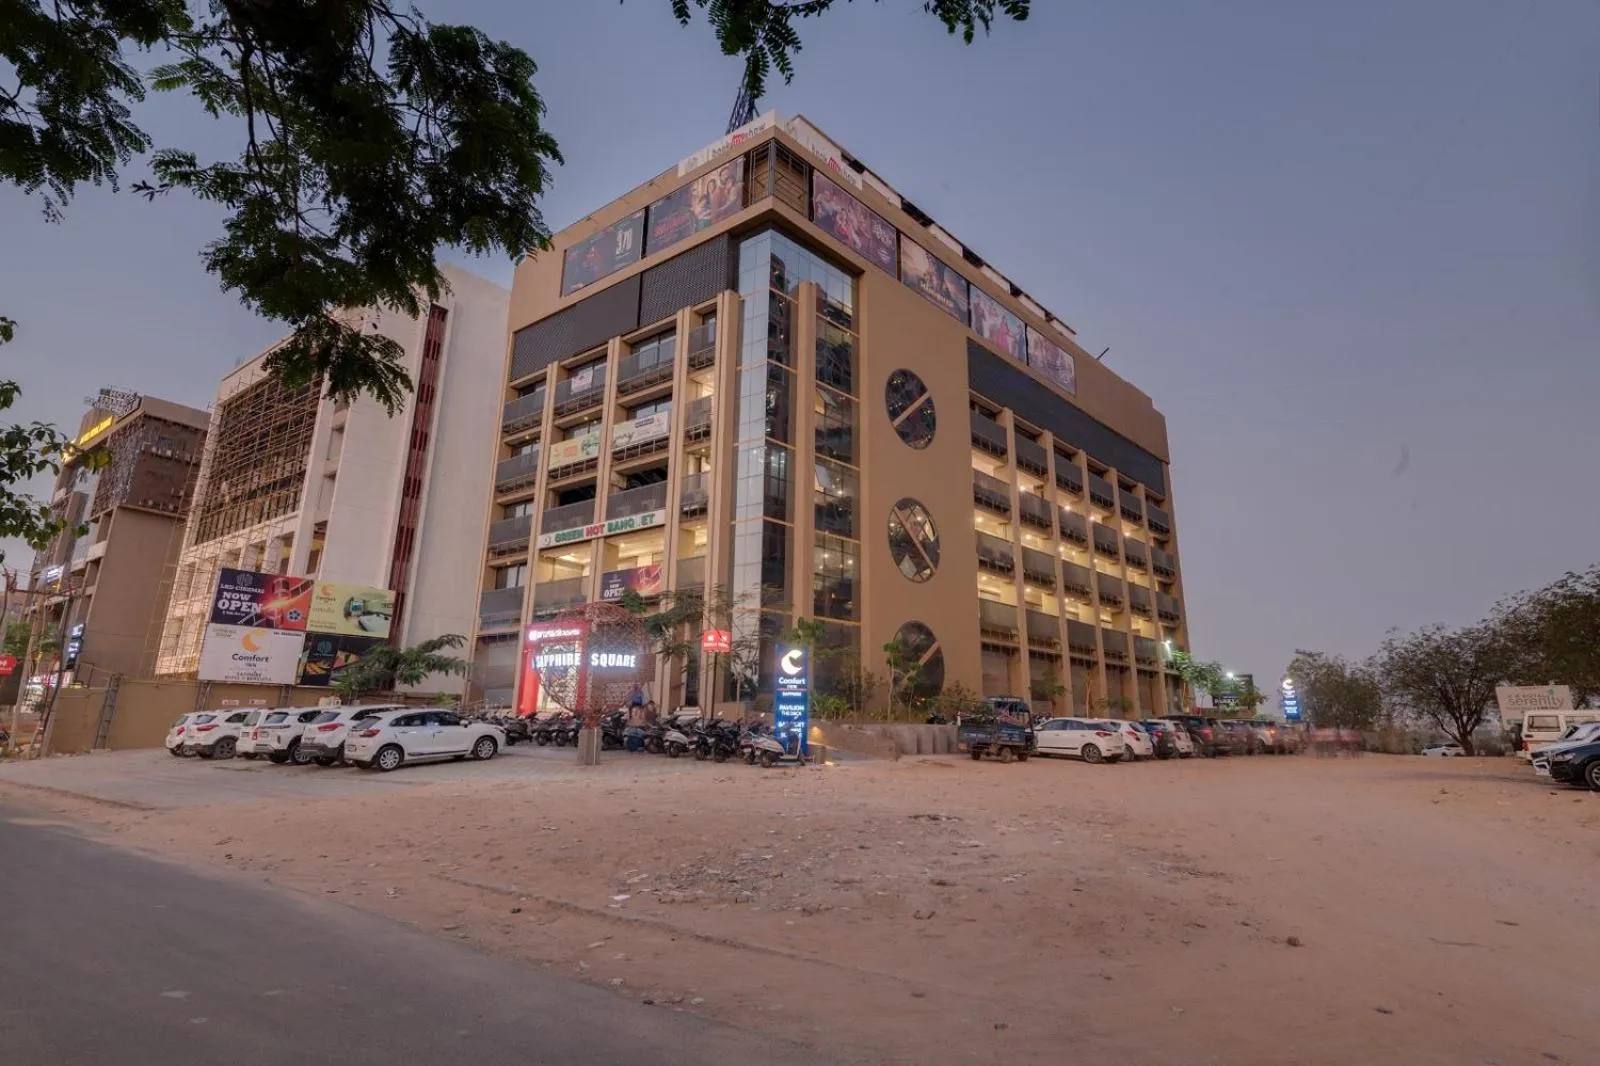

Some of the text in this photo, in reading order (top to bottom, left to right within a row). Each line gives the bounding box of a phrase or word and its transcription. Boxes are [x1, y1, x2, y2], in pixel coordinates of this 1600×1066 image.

[554, 528, 584, 543] GREEN
[607, 513, 656, 533] BANQET
[222, 591, 252, 601] NOW
[217, 598, 263, 613] OPEN
[232, 653, 270, 663] Comfort
[533, 653, 637, 668] SAPPHIRE SQUARE
[779, 677, 806, 685] Comfort
[1507, 695, 1565, 709] serenity
